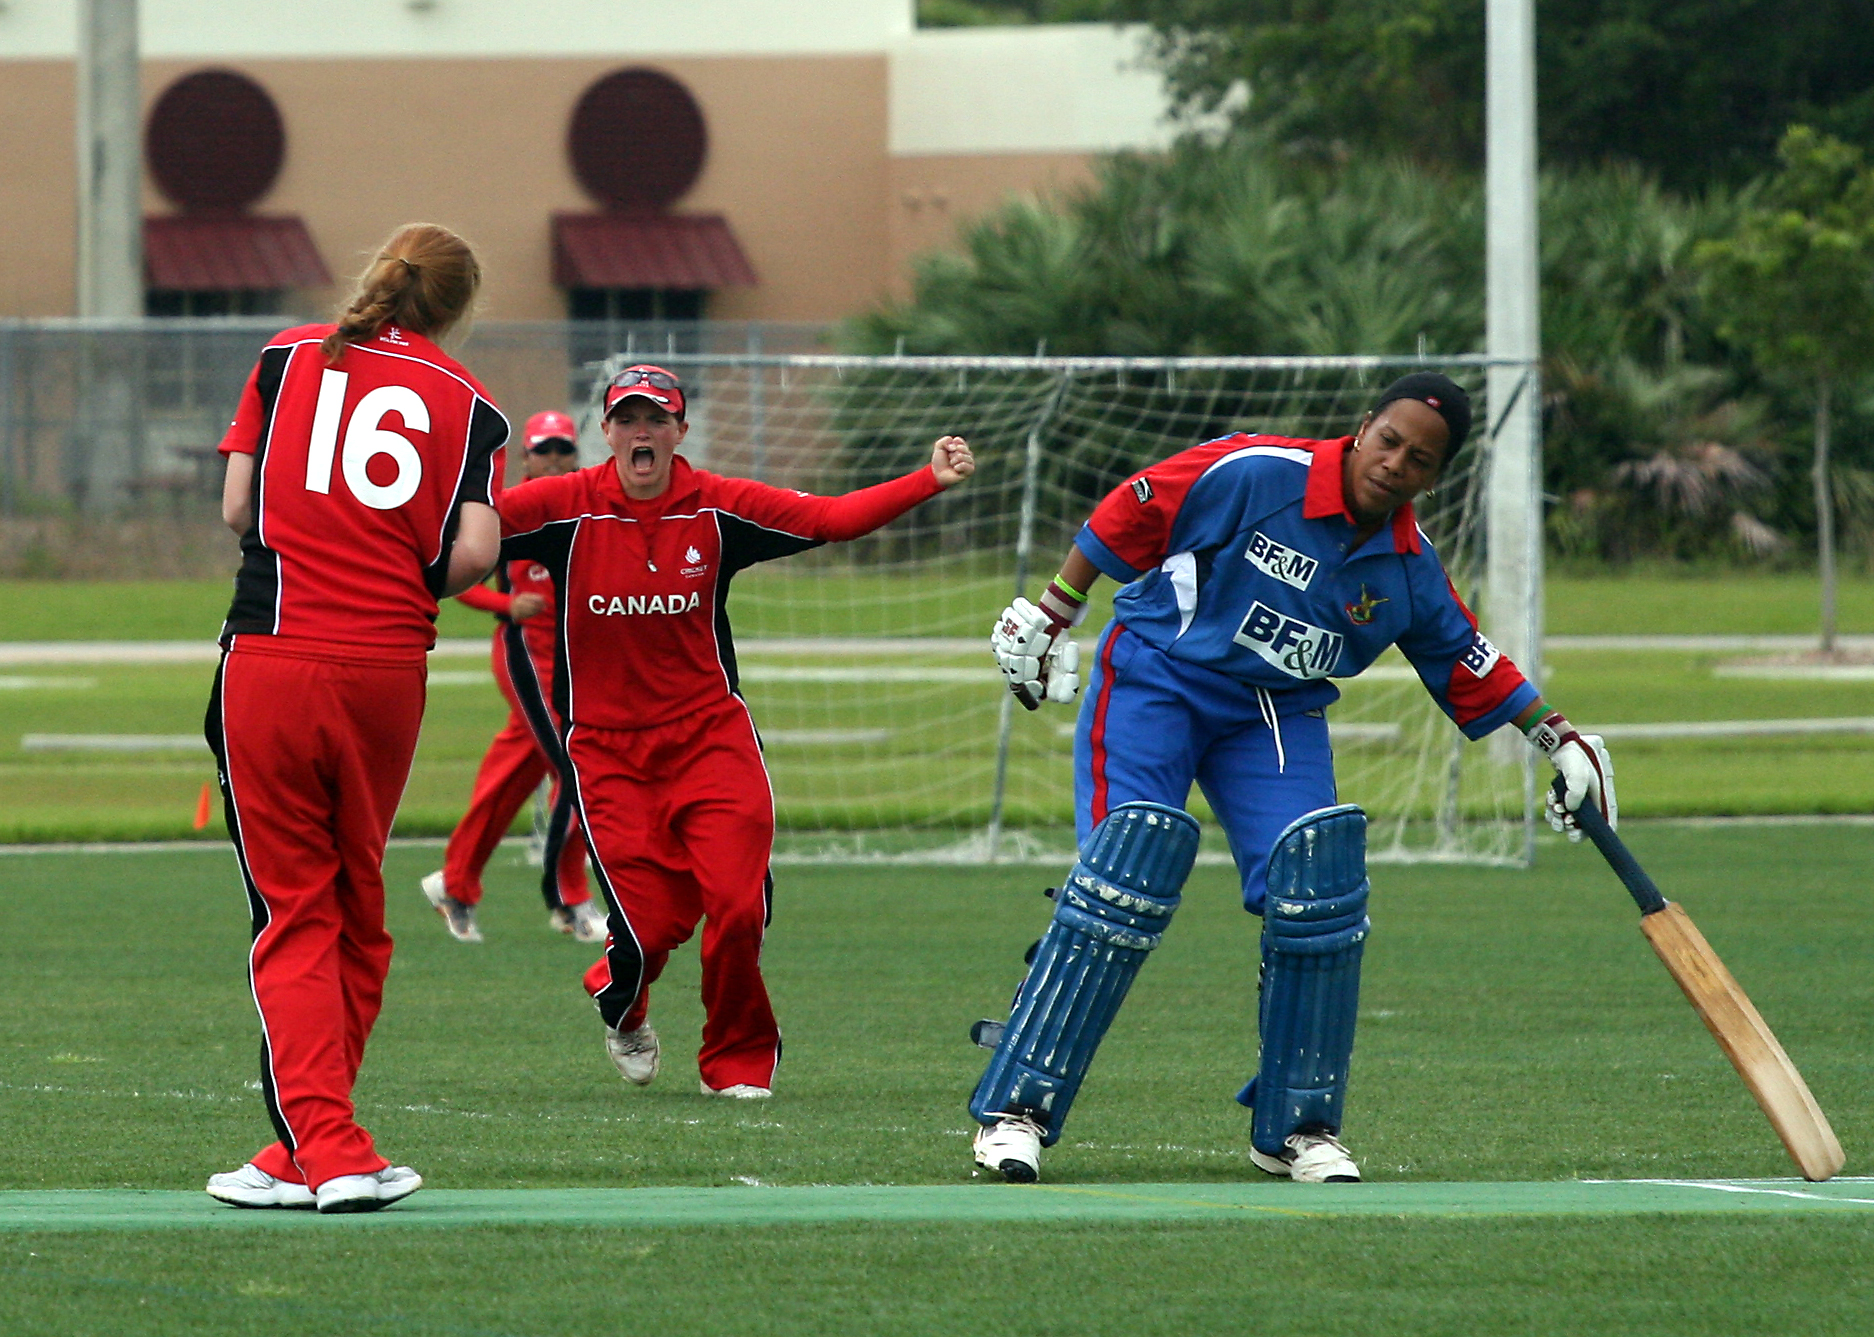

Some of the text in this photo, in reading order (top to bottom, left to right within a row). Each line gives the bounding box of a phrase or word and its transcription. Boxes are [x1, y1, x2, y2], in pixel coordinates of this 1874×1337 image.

[305, 368, 431, 510] 16
[1249, 533, 1315, 582] BF&M
[588, 591, 700, 616] CANADA
[1241, 603, 1343, 678] BF&M
